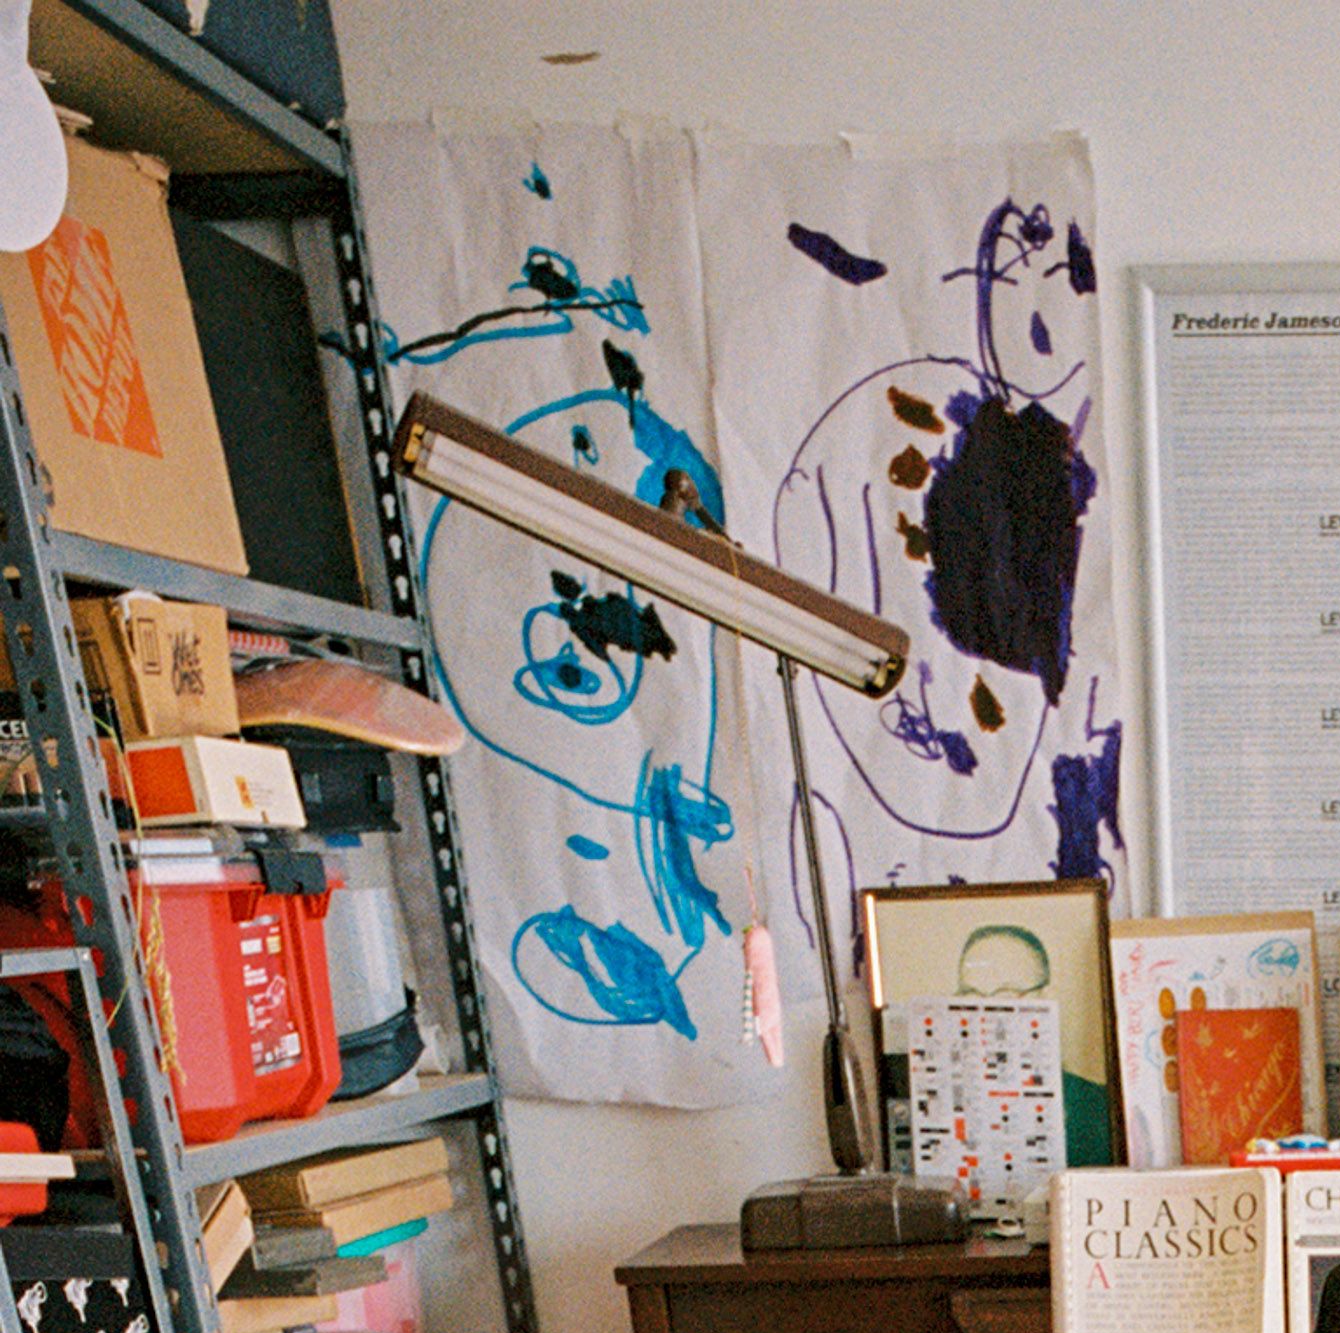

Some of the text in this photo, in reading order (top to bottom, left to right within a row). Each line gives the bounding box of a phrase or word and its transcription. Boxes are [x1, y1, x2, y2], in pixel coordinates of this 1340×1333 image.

[1172, 313, 1260, 330] Frederic
[1086, 1191, 1257, 1227] PIANO
[1084, 1224, 1258, 1259] CLASSICS
